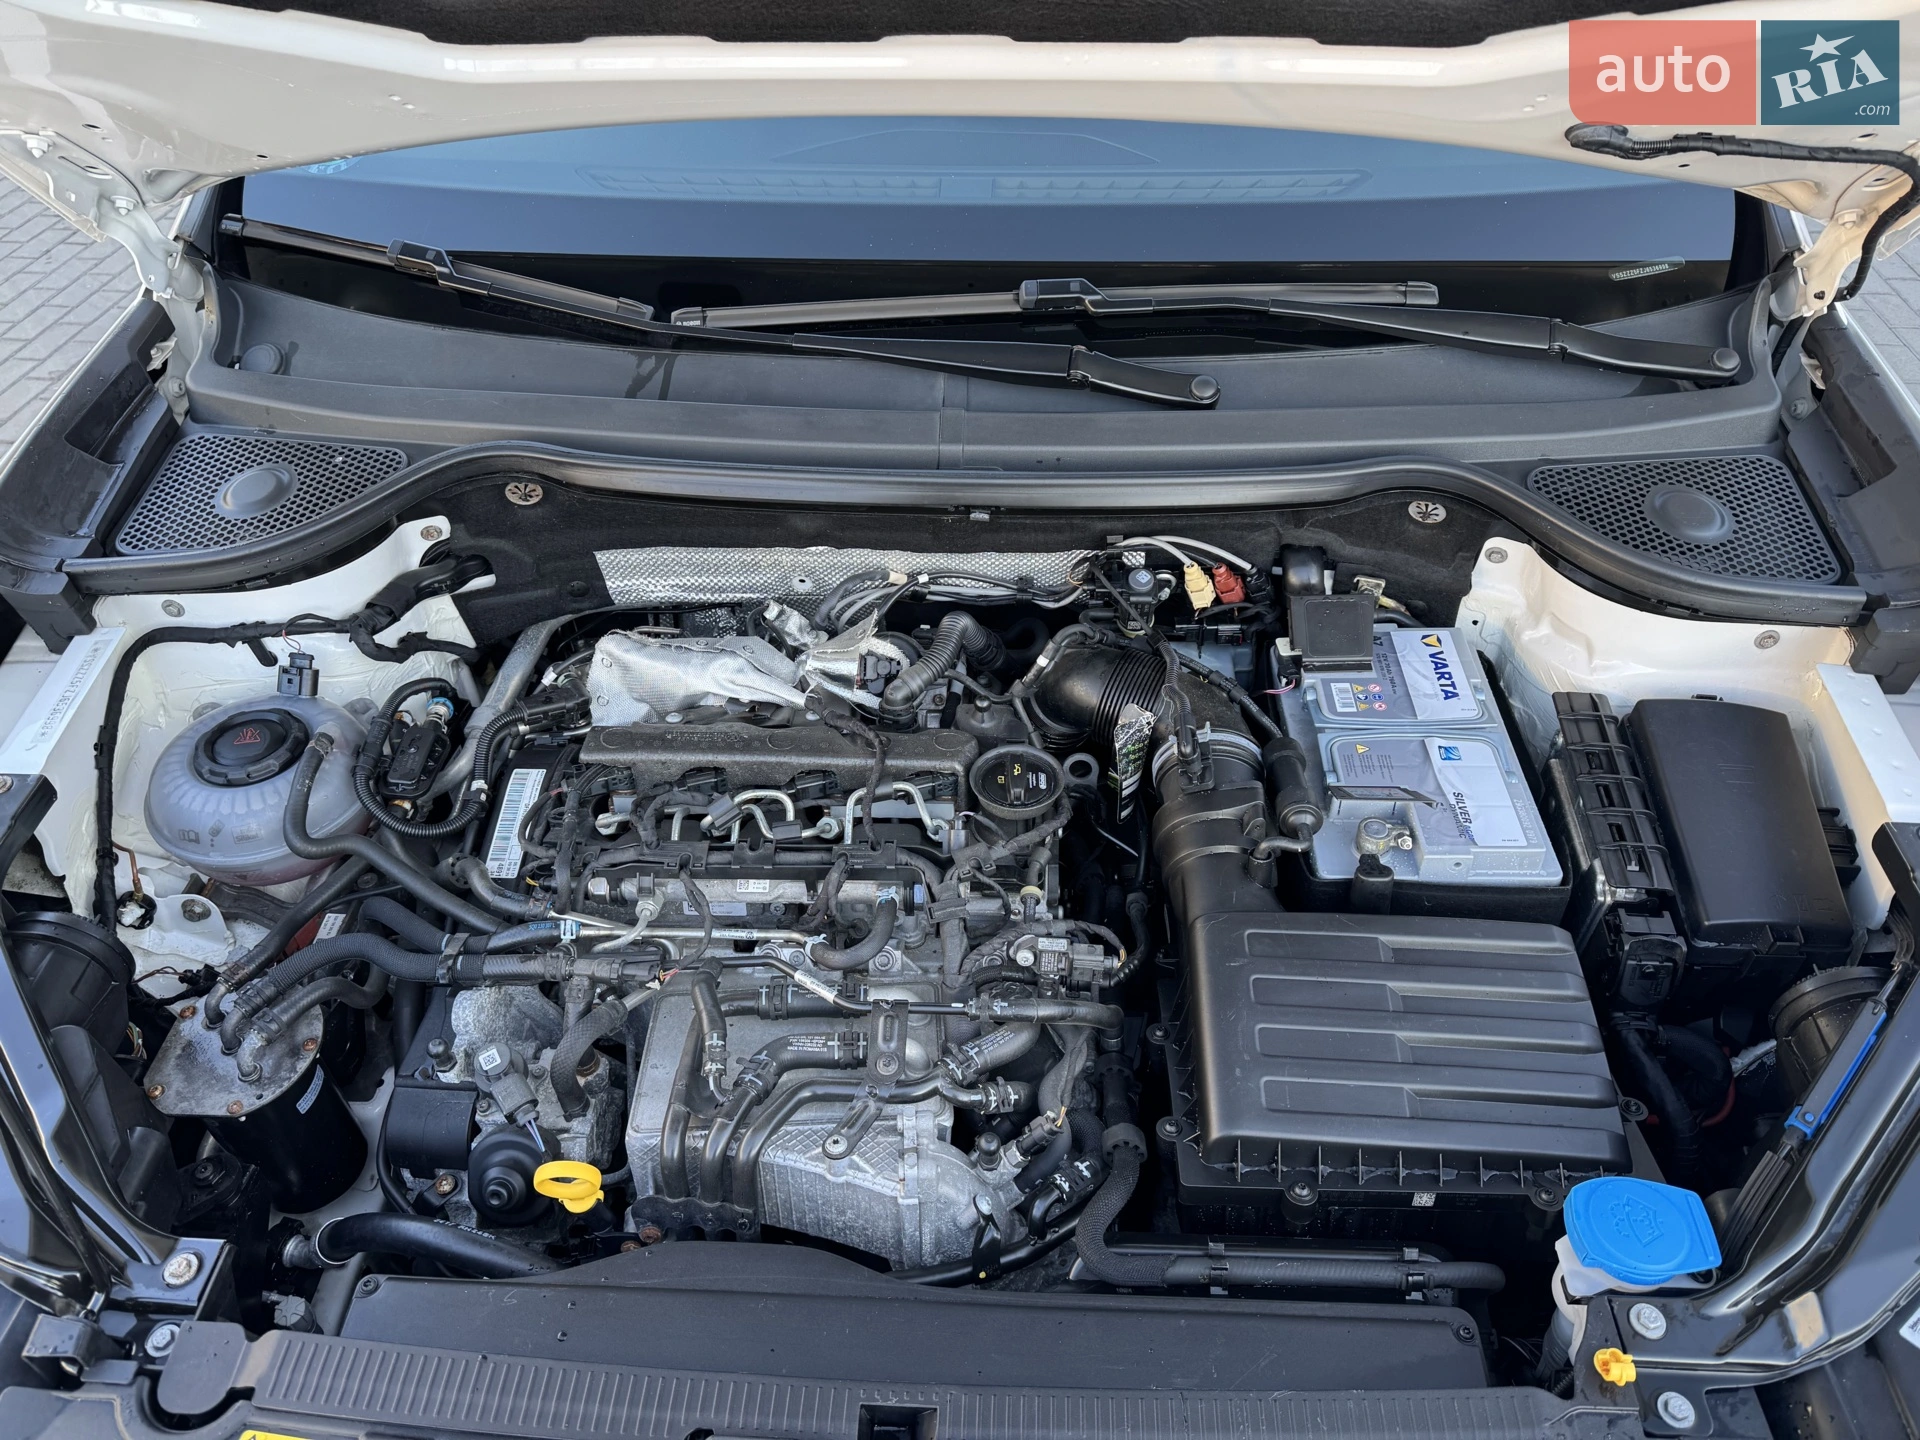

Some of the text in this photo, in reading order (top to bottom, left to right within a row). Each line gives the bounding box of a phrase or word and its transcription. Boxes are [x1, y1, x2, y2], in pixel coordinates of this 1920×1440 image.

[1428, 650, 1460, 701] VARTA
[1449, 803, 1467, 839] DYNAMIC
[1453, 791, 1473, 825] SILVER
